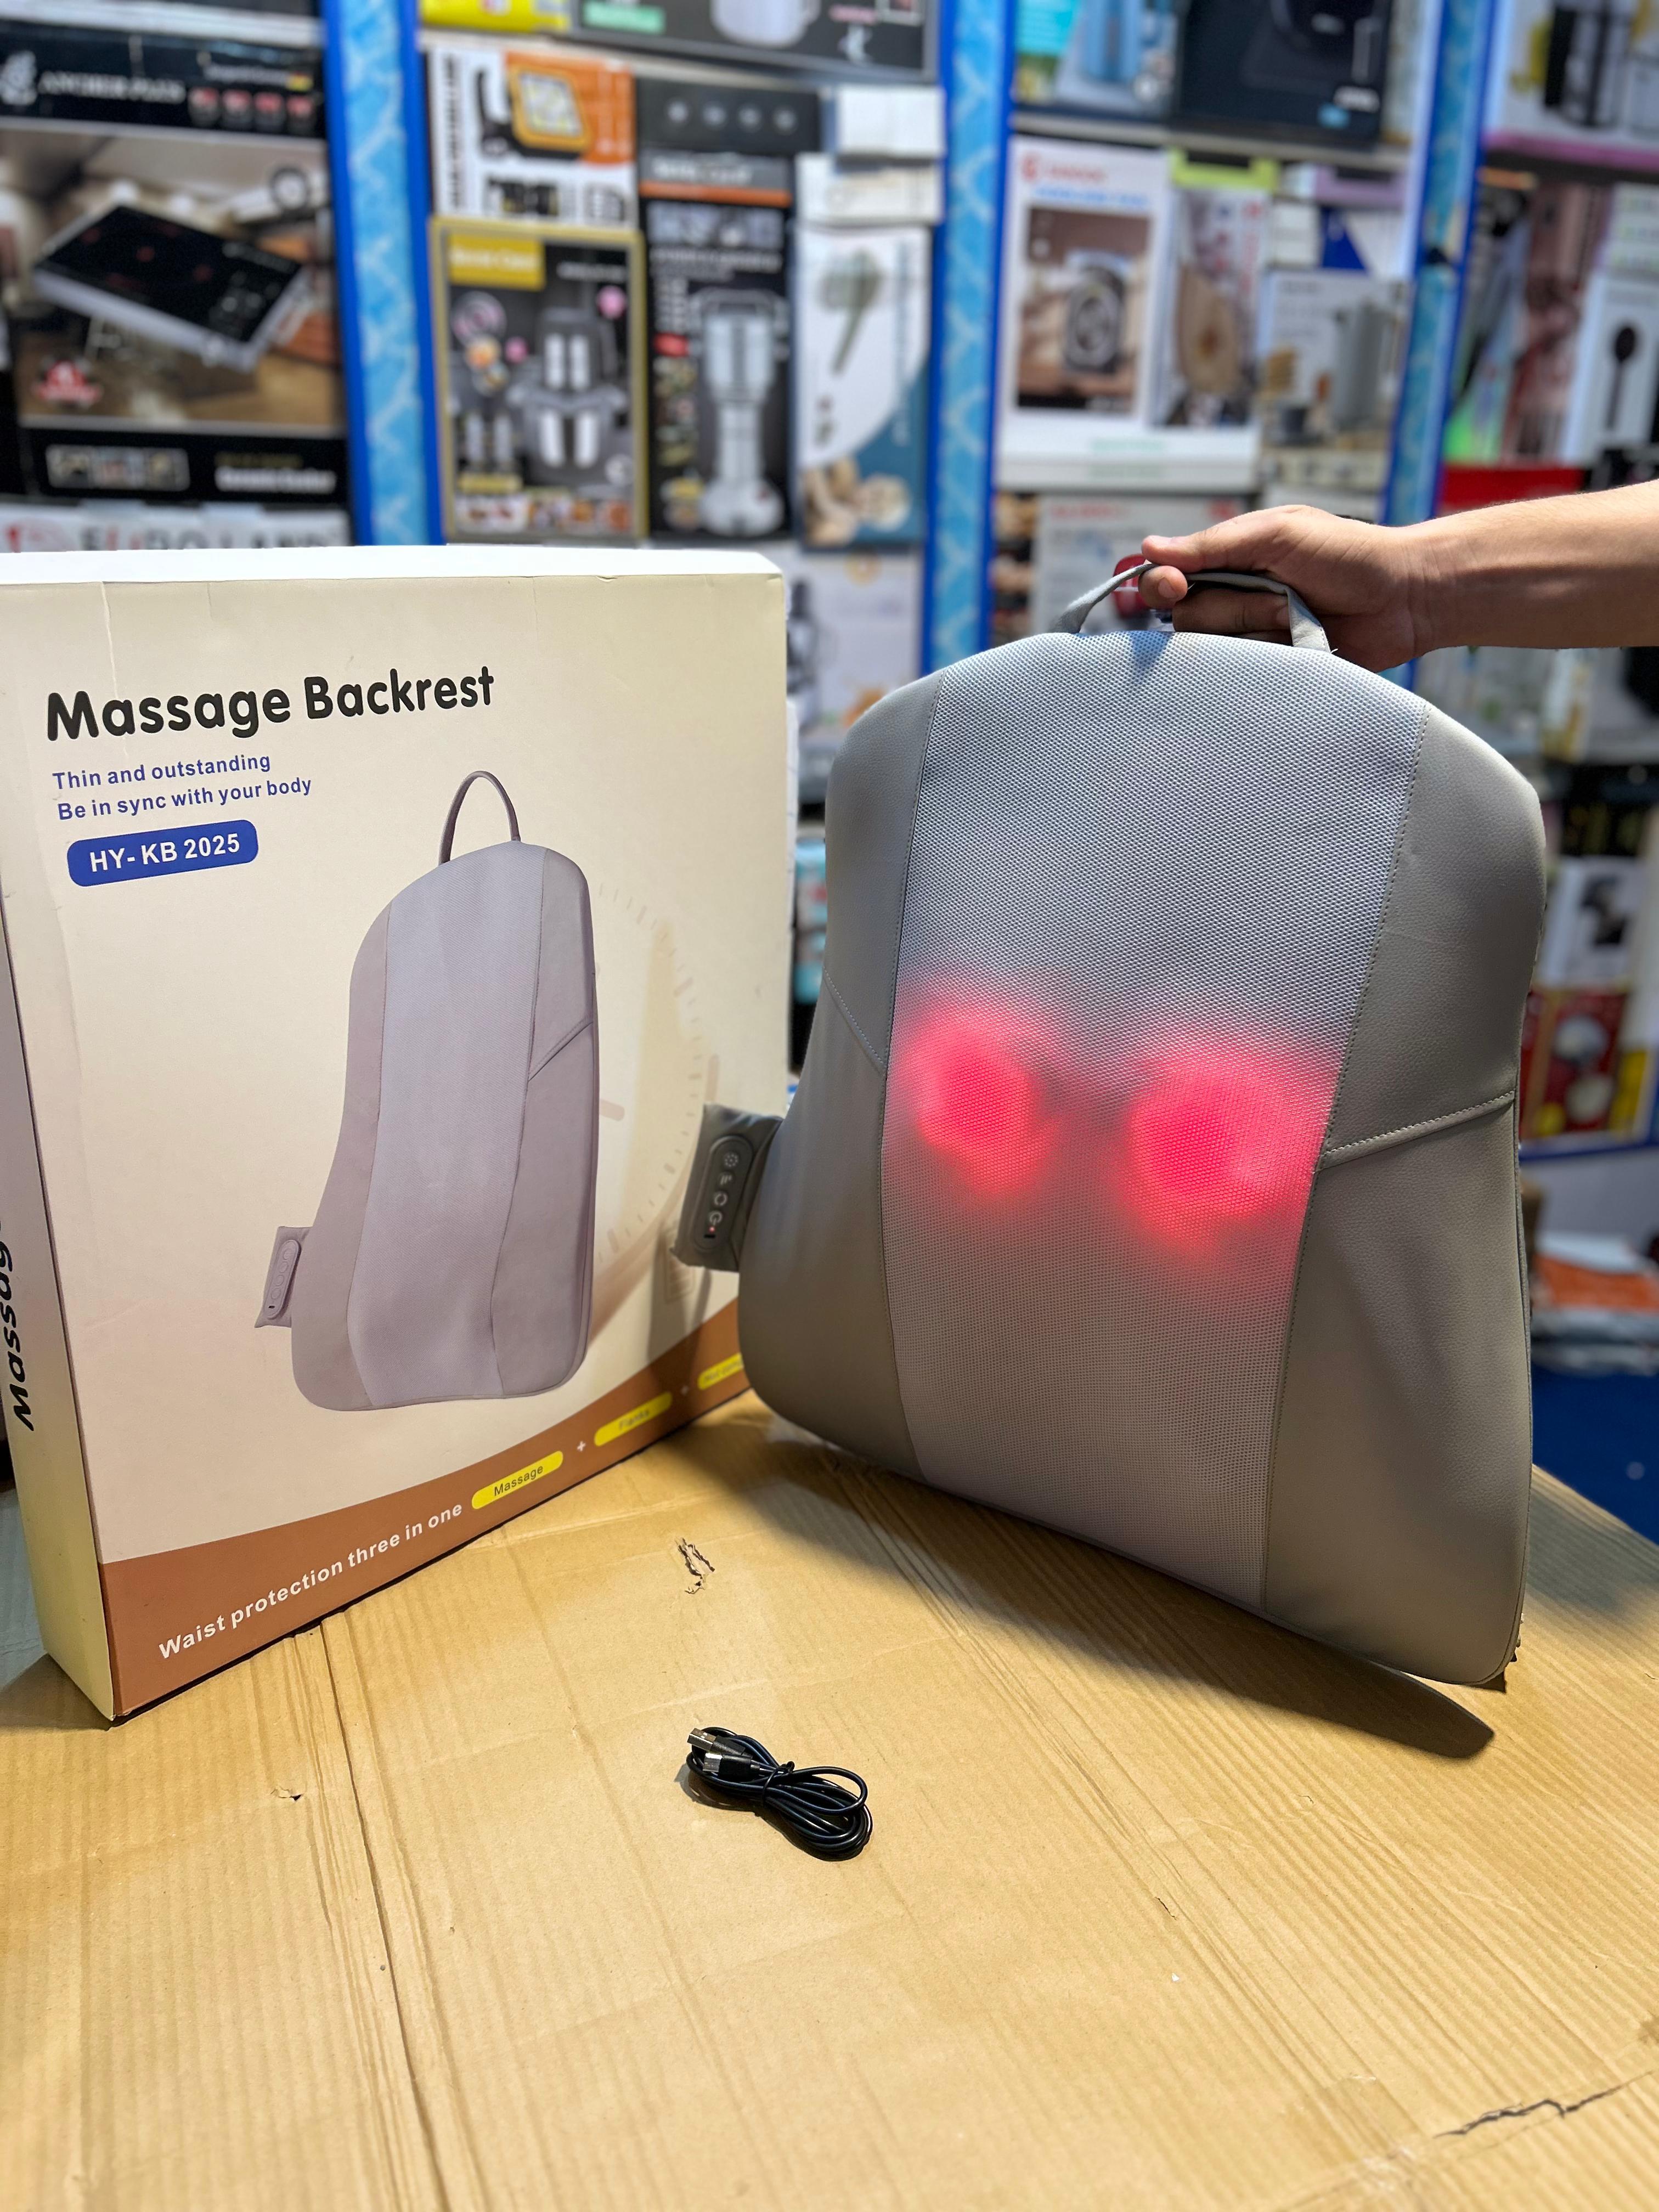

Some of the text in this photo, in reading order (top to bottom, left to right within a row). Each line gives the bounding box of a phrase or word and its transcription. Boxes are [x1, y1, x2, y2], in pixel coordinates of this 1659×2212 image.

[47, 665, 494, 742] Massage Backrest
[52, 754, 270, 789] Thin and outstanding
[58, 777, 311, 820] Be in sync with your body
[89, 833, 240, 872] HY- KB 2025
[0, 1220, 34, 1432] Massag
[159, 1615, 226, 1660] Waist
[231, 1560, 343, 1629] protection
[348, 1534, 400, 1567] three
[405, 1522, 423, 1541] in
[428, 1504, 462, 1528] one
[494, 1465, 544, 1497] Massage
